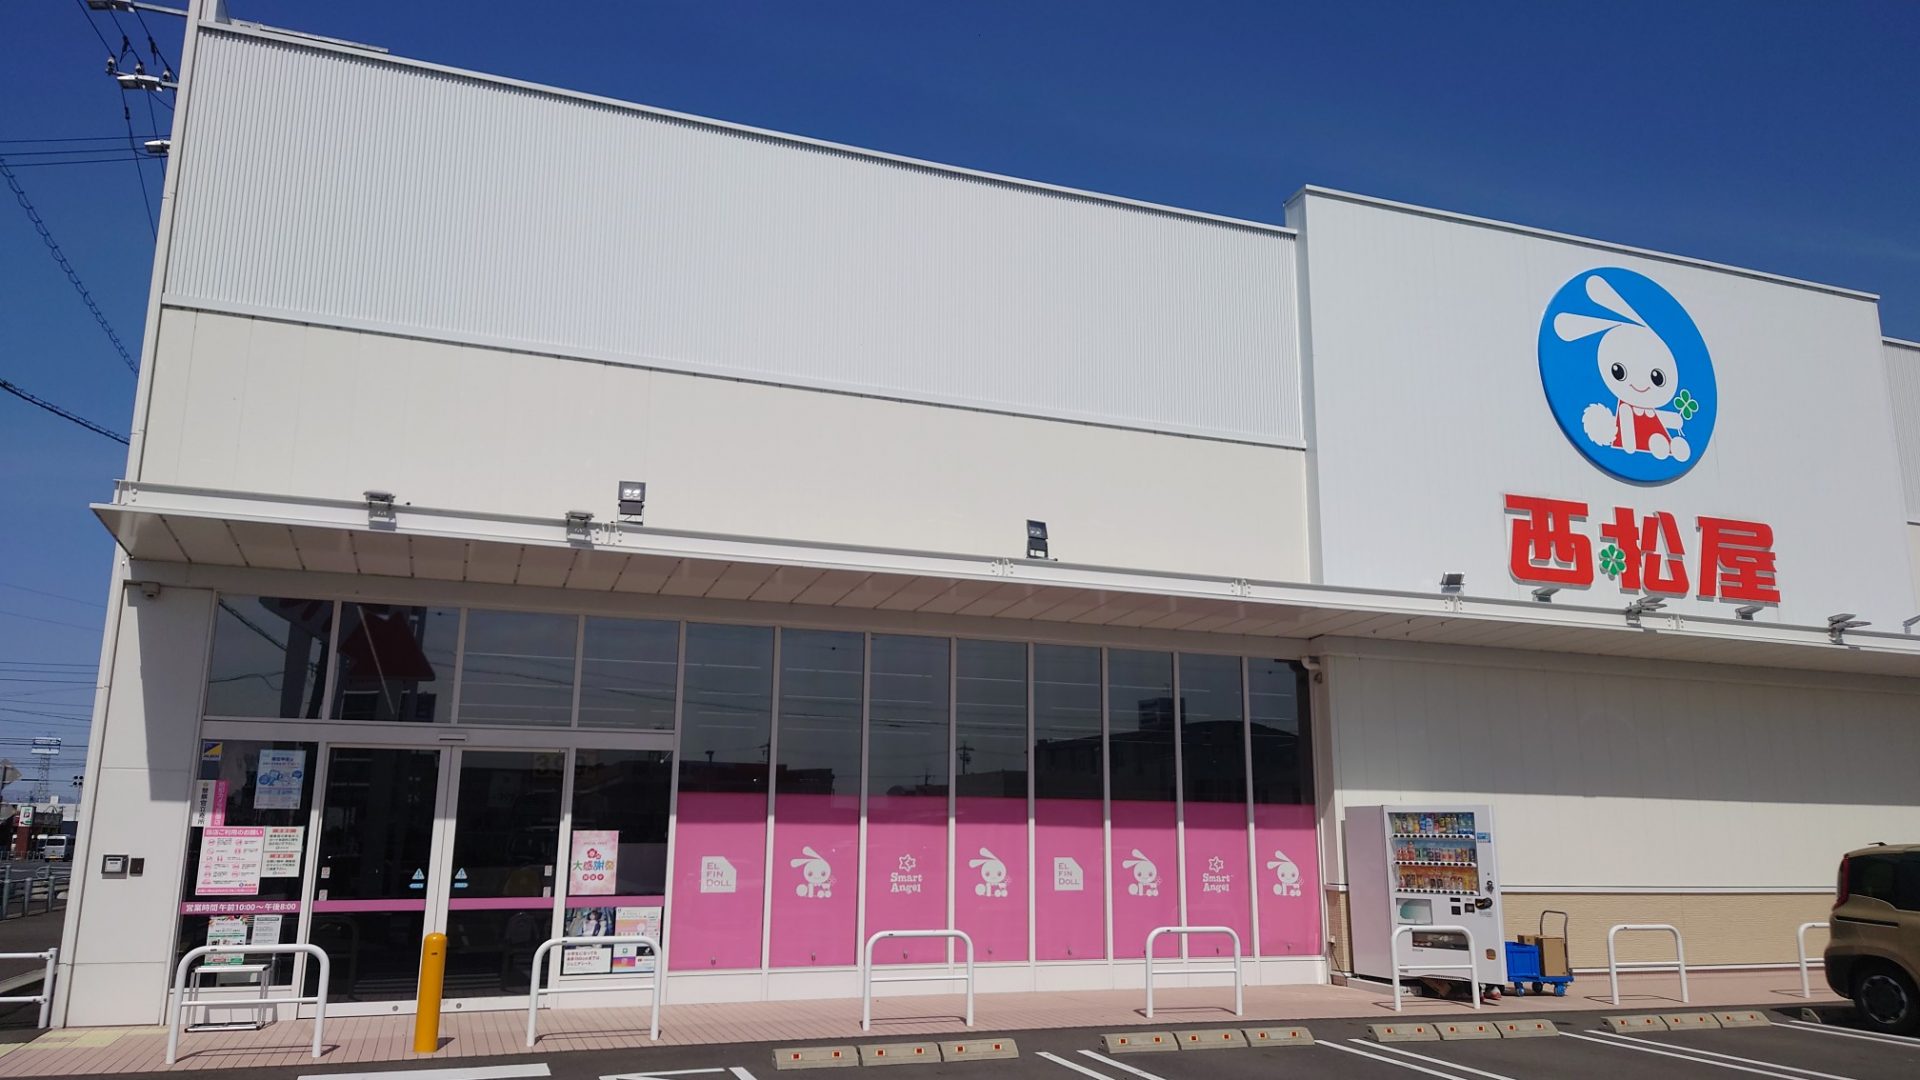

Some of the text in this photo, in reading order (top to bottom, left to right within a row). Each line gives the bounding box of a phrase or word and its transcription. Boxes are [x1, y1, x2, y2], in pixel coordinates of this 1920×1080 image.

[1504, 493, 1781, 604] 西松屋
[706, 862, 720, 870] EL
[890, 872, 923, 882] Smart
[1202, 873, 1231, 882] Smart
[890, 883, 921, 895] Angel
[1203, 883, 1230, 893] Angel
